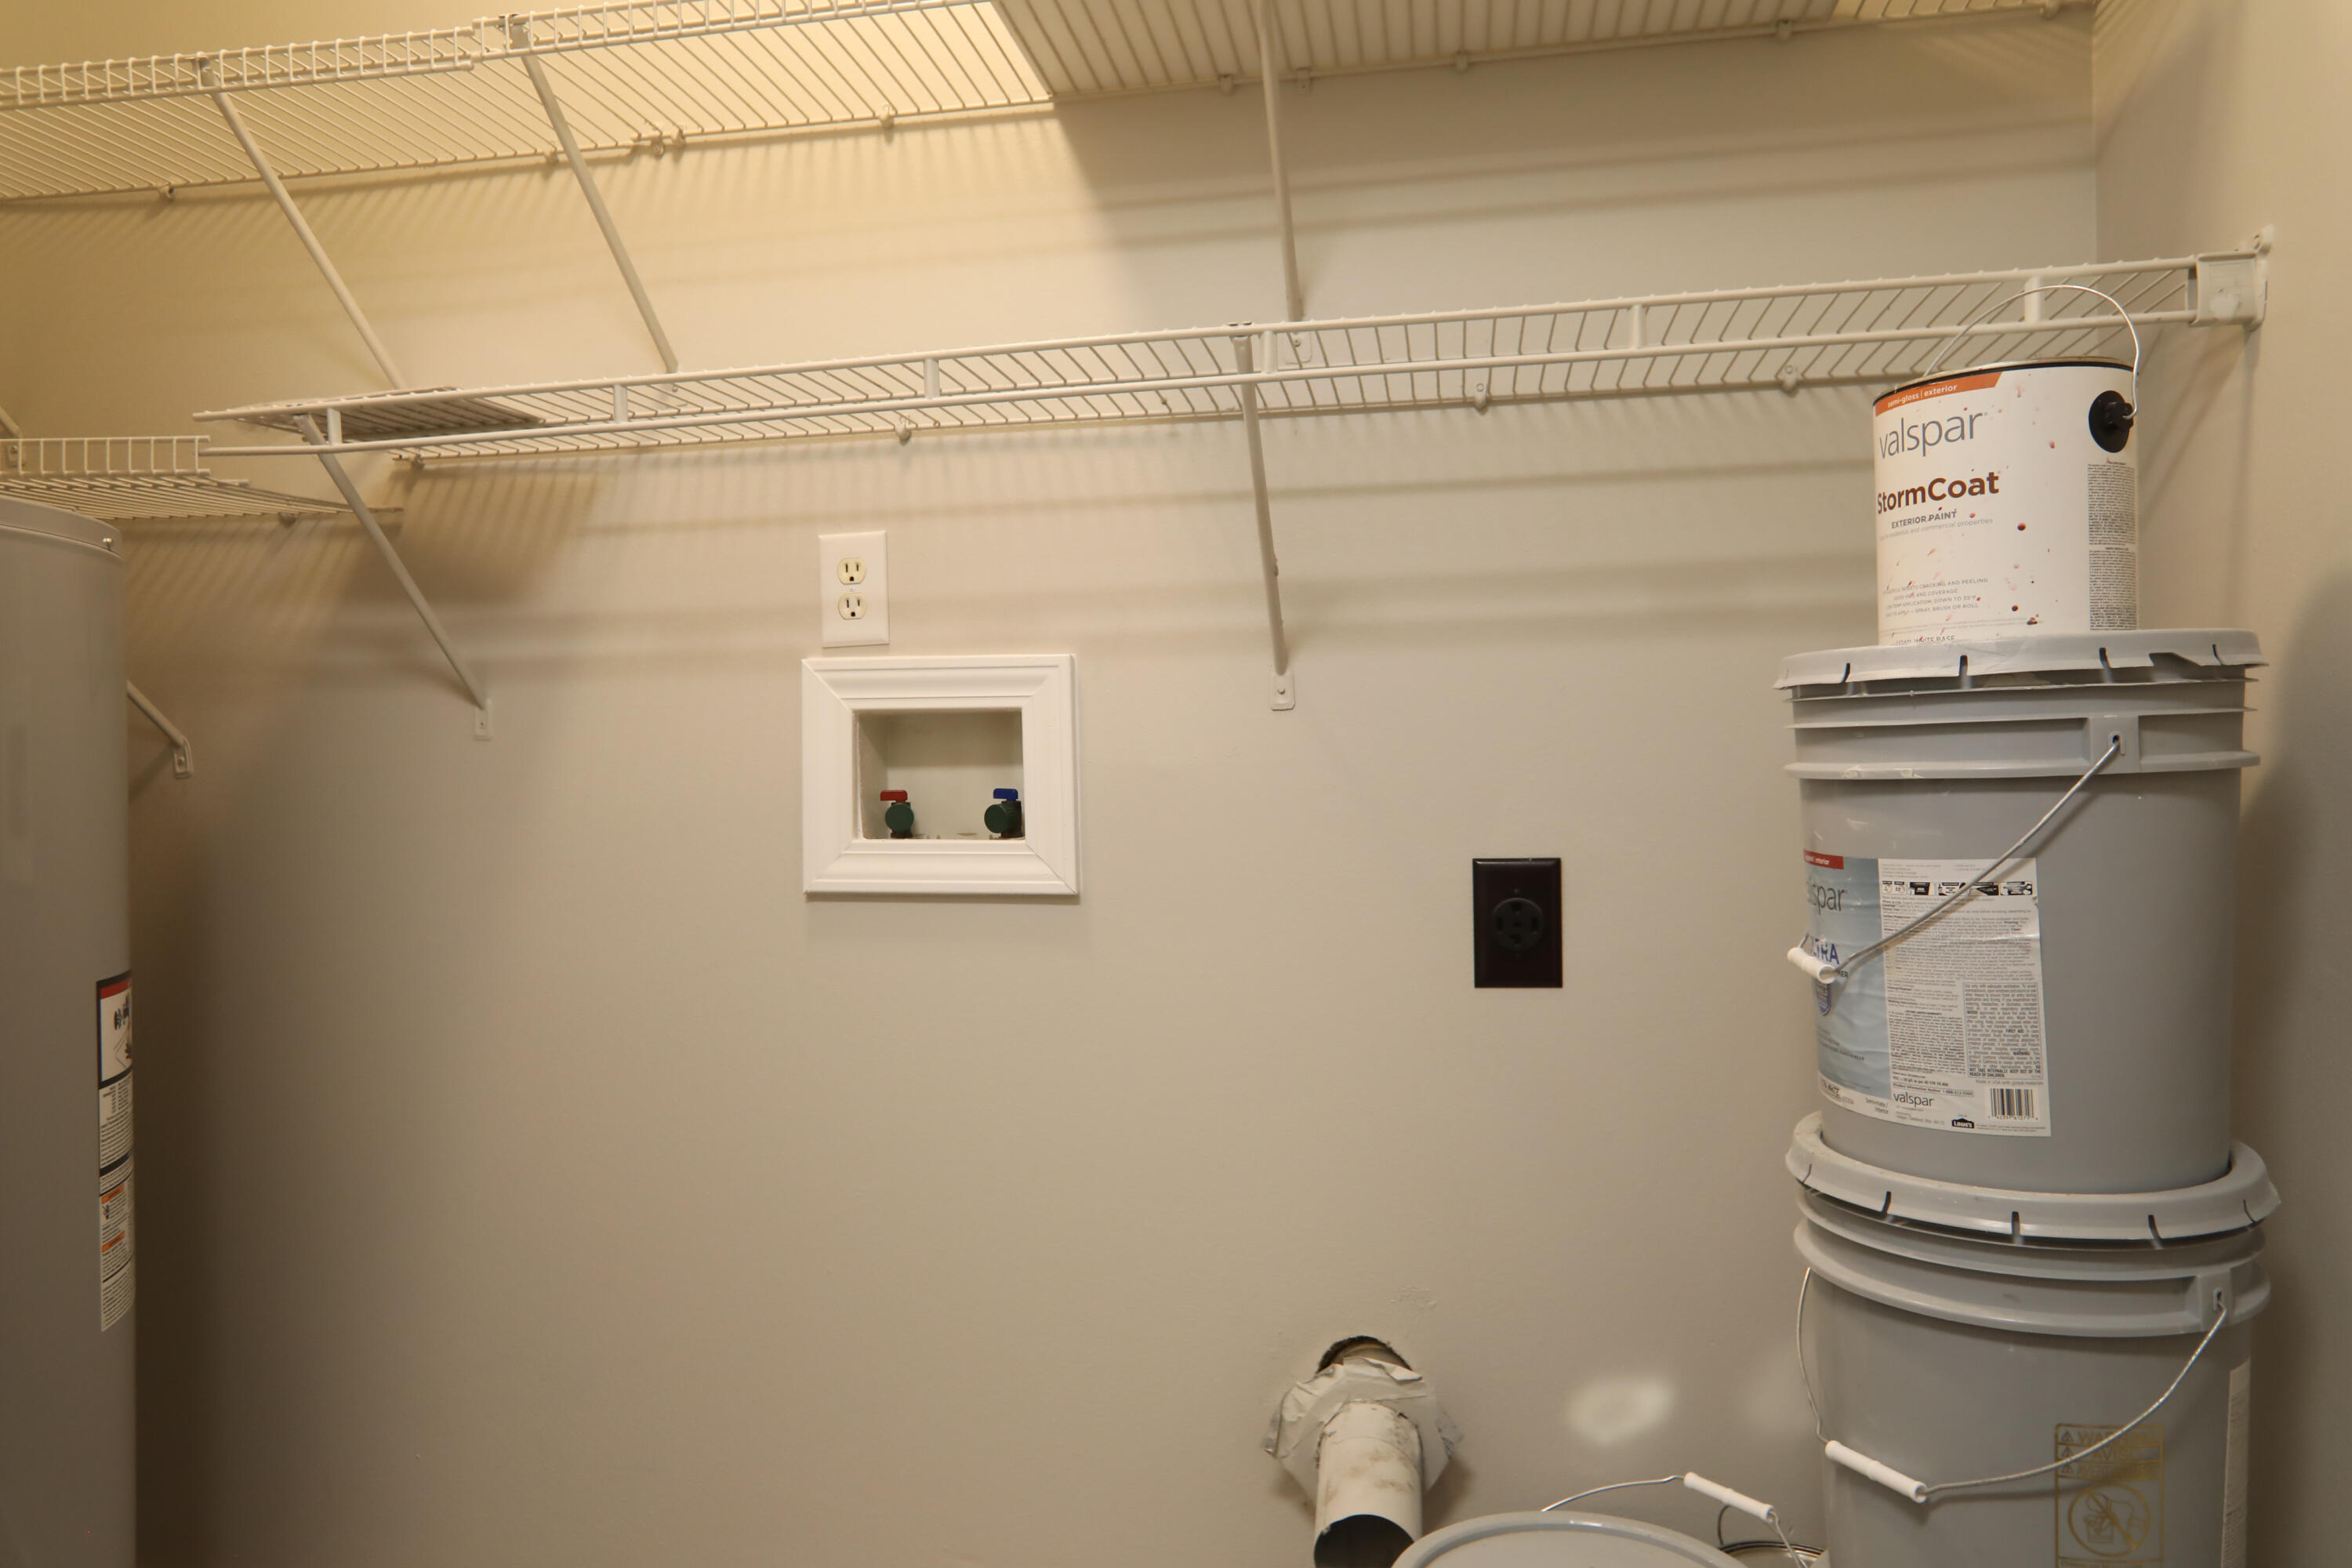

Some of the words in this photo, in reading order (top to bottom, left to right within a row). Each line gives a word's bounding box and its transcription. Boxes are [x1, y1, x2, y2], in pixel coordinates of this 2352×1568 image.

[1887, 392, 1920, 408] semi-gloss
[1924, 384, 1958, 397] exterior
[1879, 412, 1983, 459] valspar
[1877, 471, 1999, 515] StormCoat
[1891, 515, 1926, 529] EXTERIOR
[1929, 510, 1957, 522] PAINT
[1893, 1091, 1935, 1108] valspar
